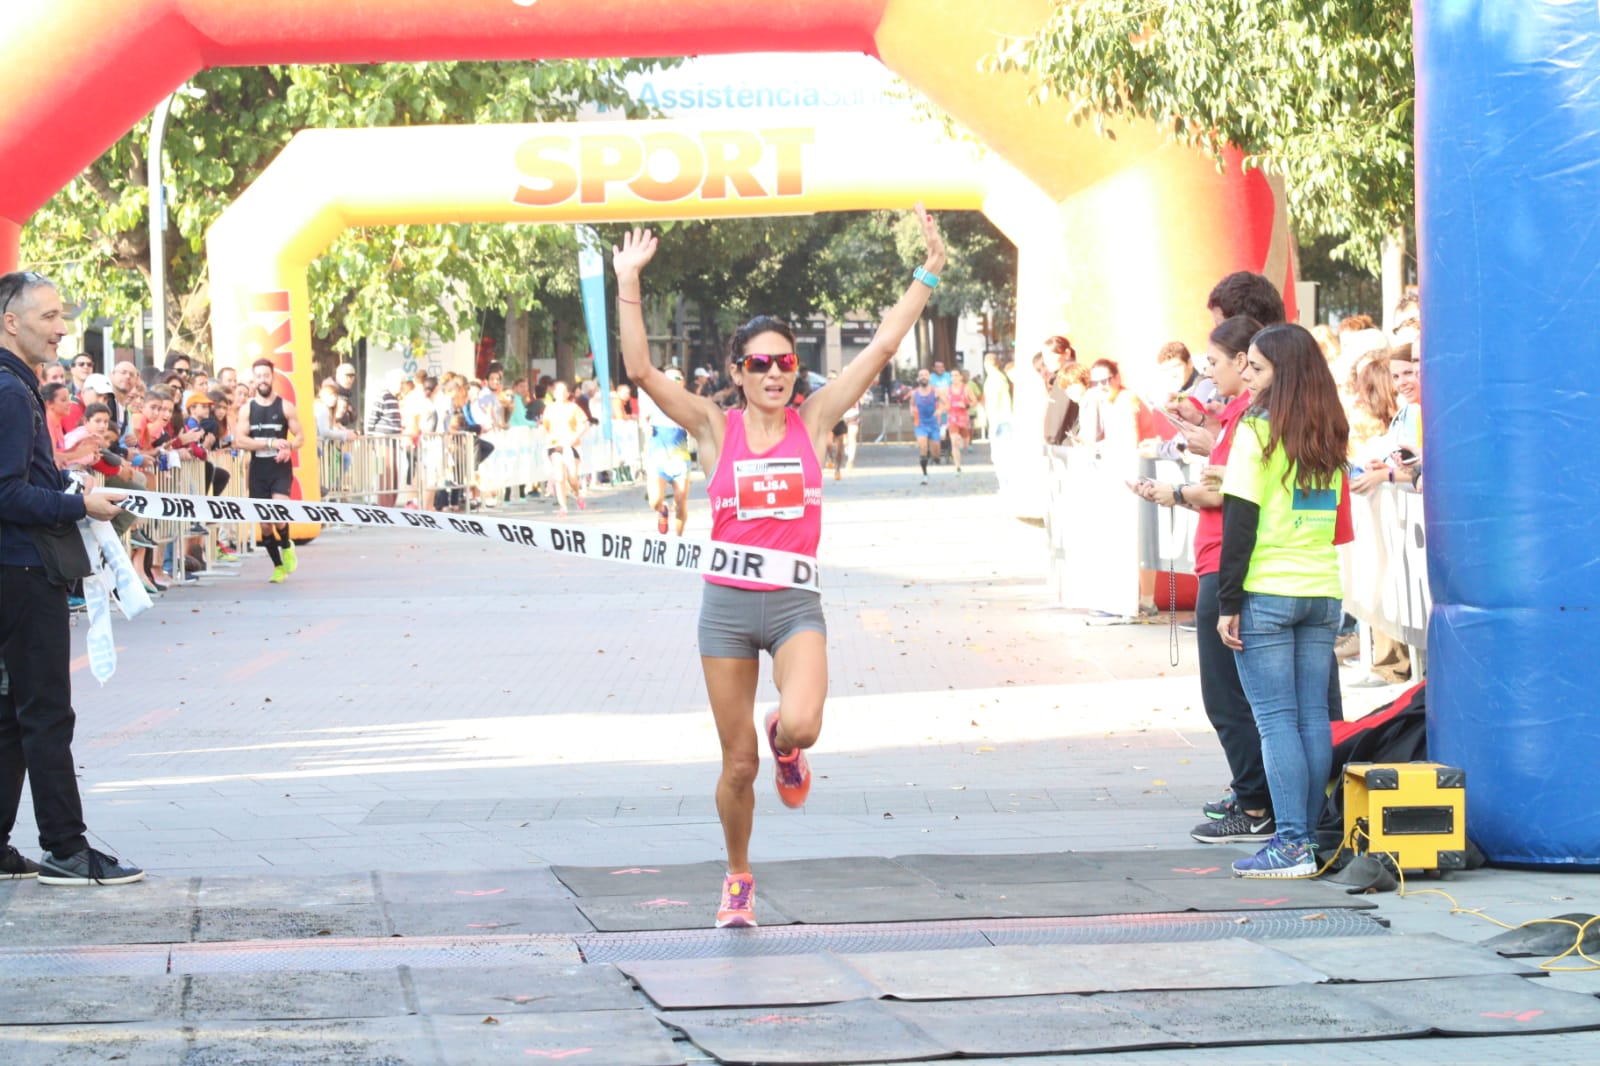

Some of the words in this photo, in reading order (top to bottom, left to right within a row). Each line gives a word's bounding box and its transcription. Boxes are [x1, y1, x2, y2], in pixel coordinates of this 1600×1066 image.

[513, 127, 816, 206] SPORT
[161, 497, 196, 518] DiR
[207, 500, 245, 520] DiR
[253, 504, 294, 521] DiR
[302, 506, 344, 523] DiR
[351, 507, 394, 524] DiR
[400, 511, 443, 529] DiR
[448, 517, 489, 537] DiR
[498, 523, 537, 547] DiR
[551, 528, 586, 554] DiR
[602, 533, 631, 559] DiR
[642, 538, 666, 565] DiR
[676, 543, 701, 568] DiR
[710, 548, 764, 578] DiR
[766, 492, 776, 504] 8
